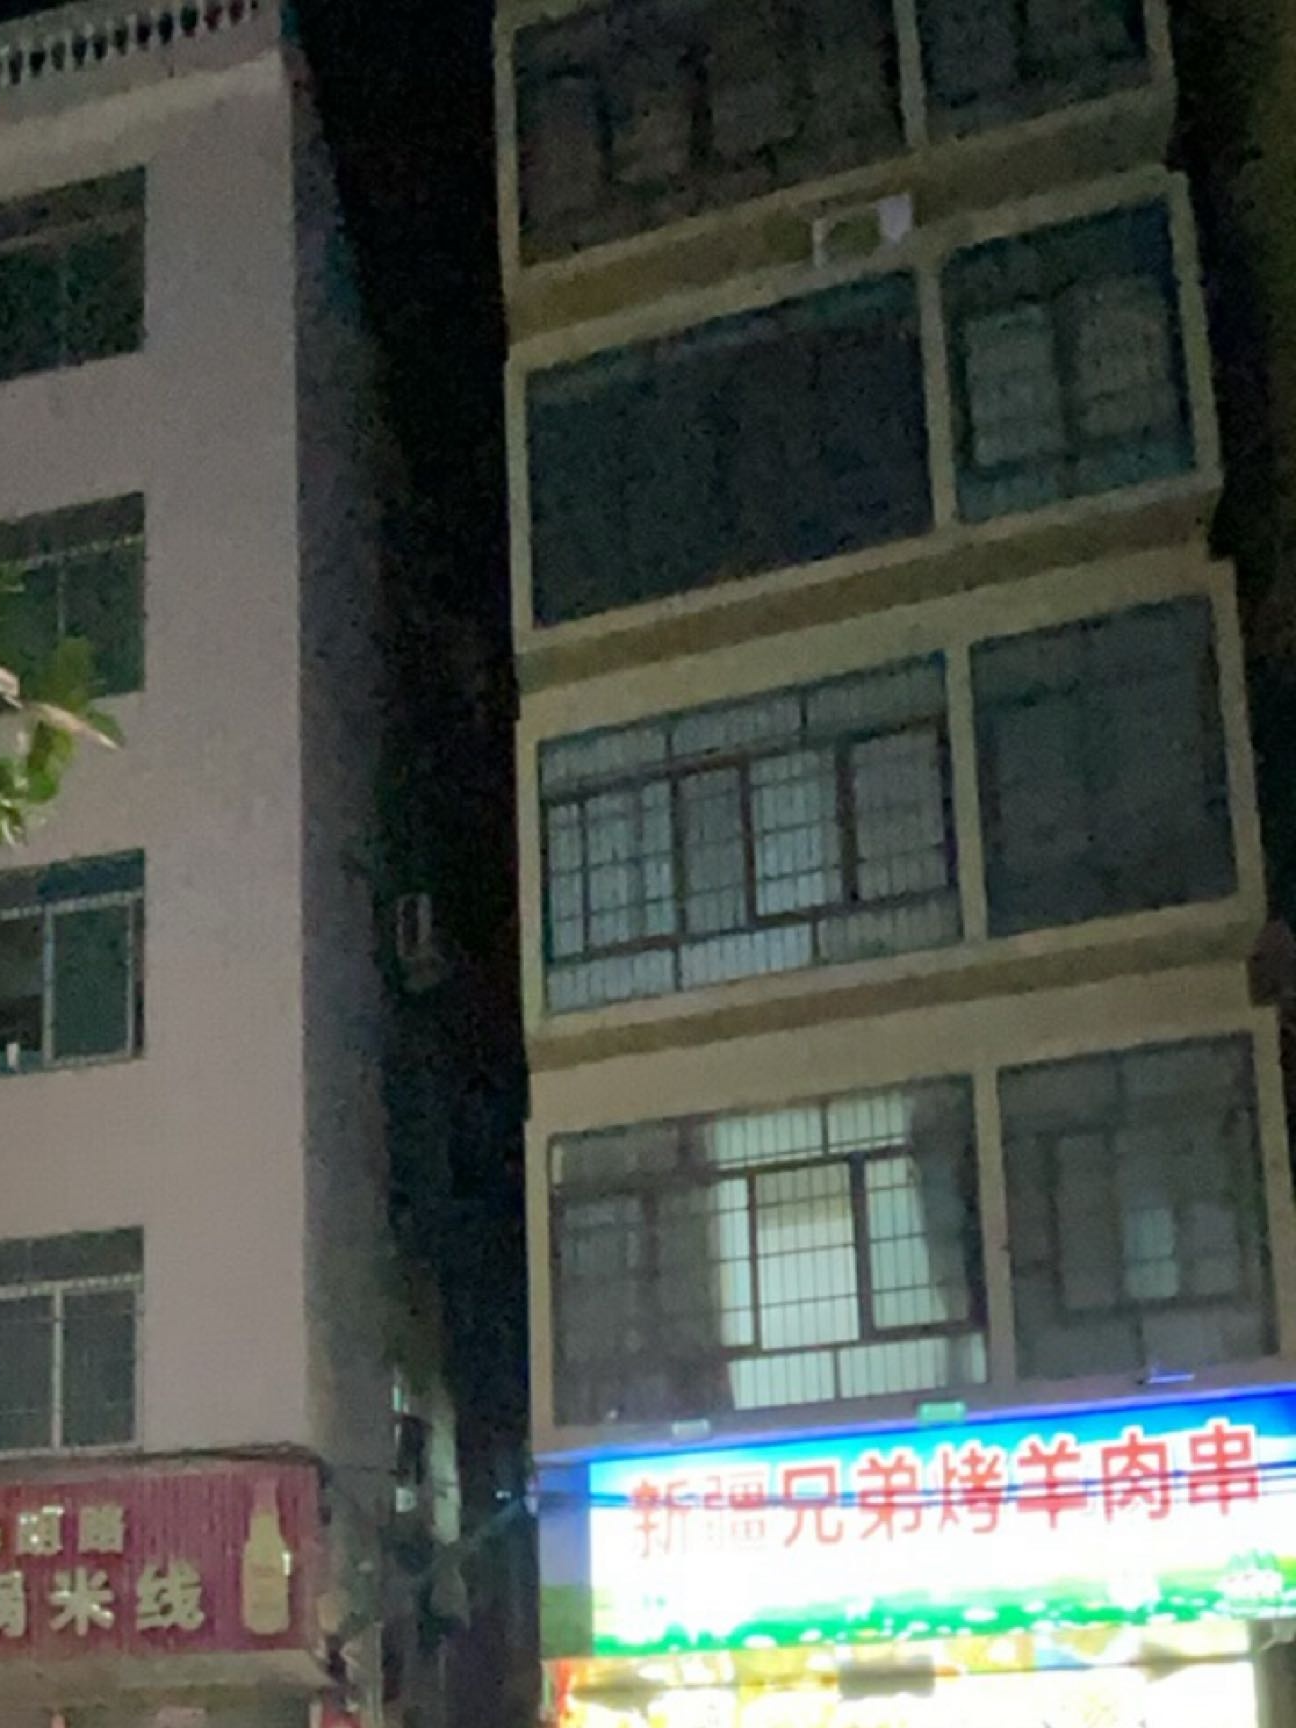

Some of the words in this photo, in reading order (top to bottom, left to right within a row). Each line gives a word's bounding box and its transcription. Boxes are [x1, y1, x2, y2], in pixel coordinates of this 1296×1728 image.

[627, 1418, 1261, 1559] 新疆兄弟烤羊肉串
